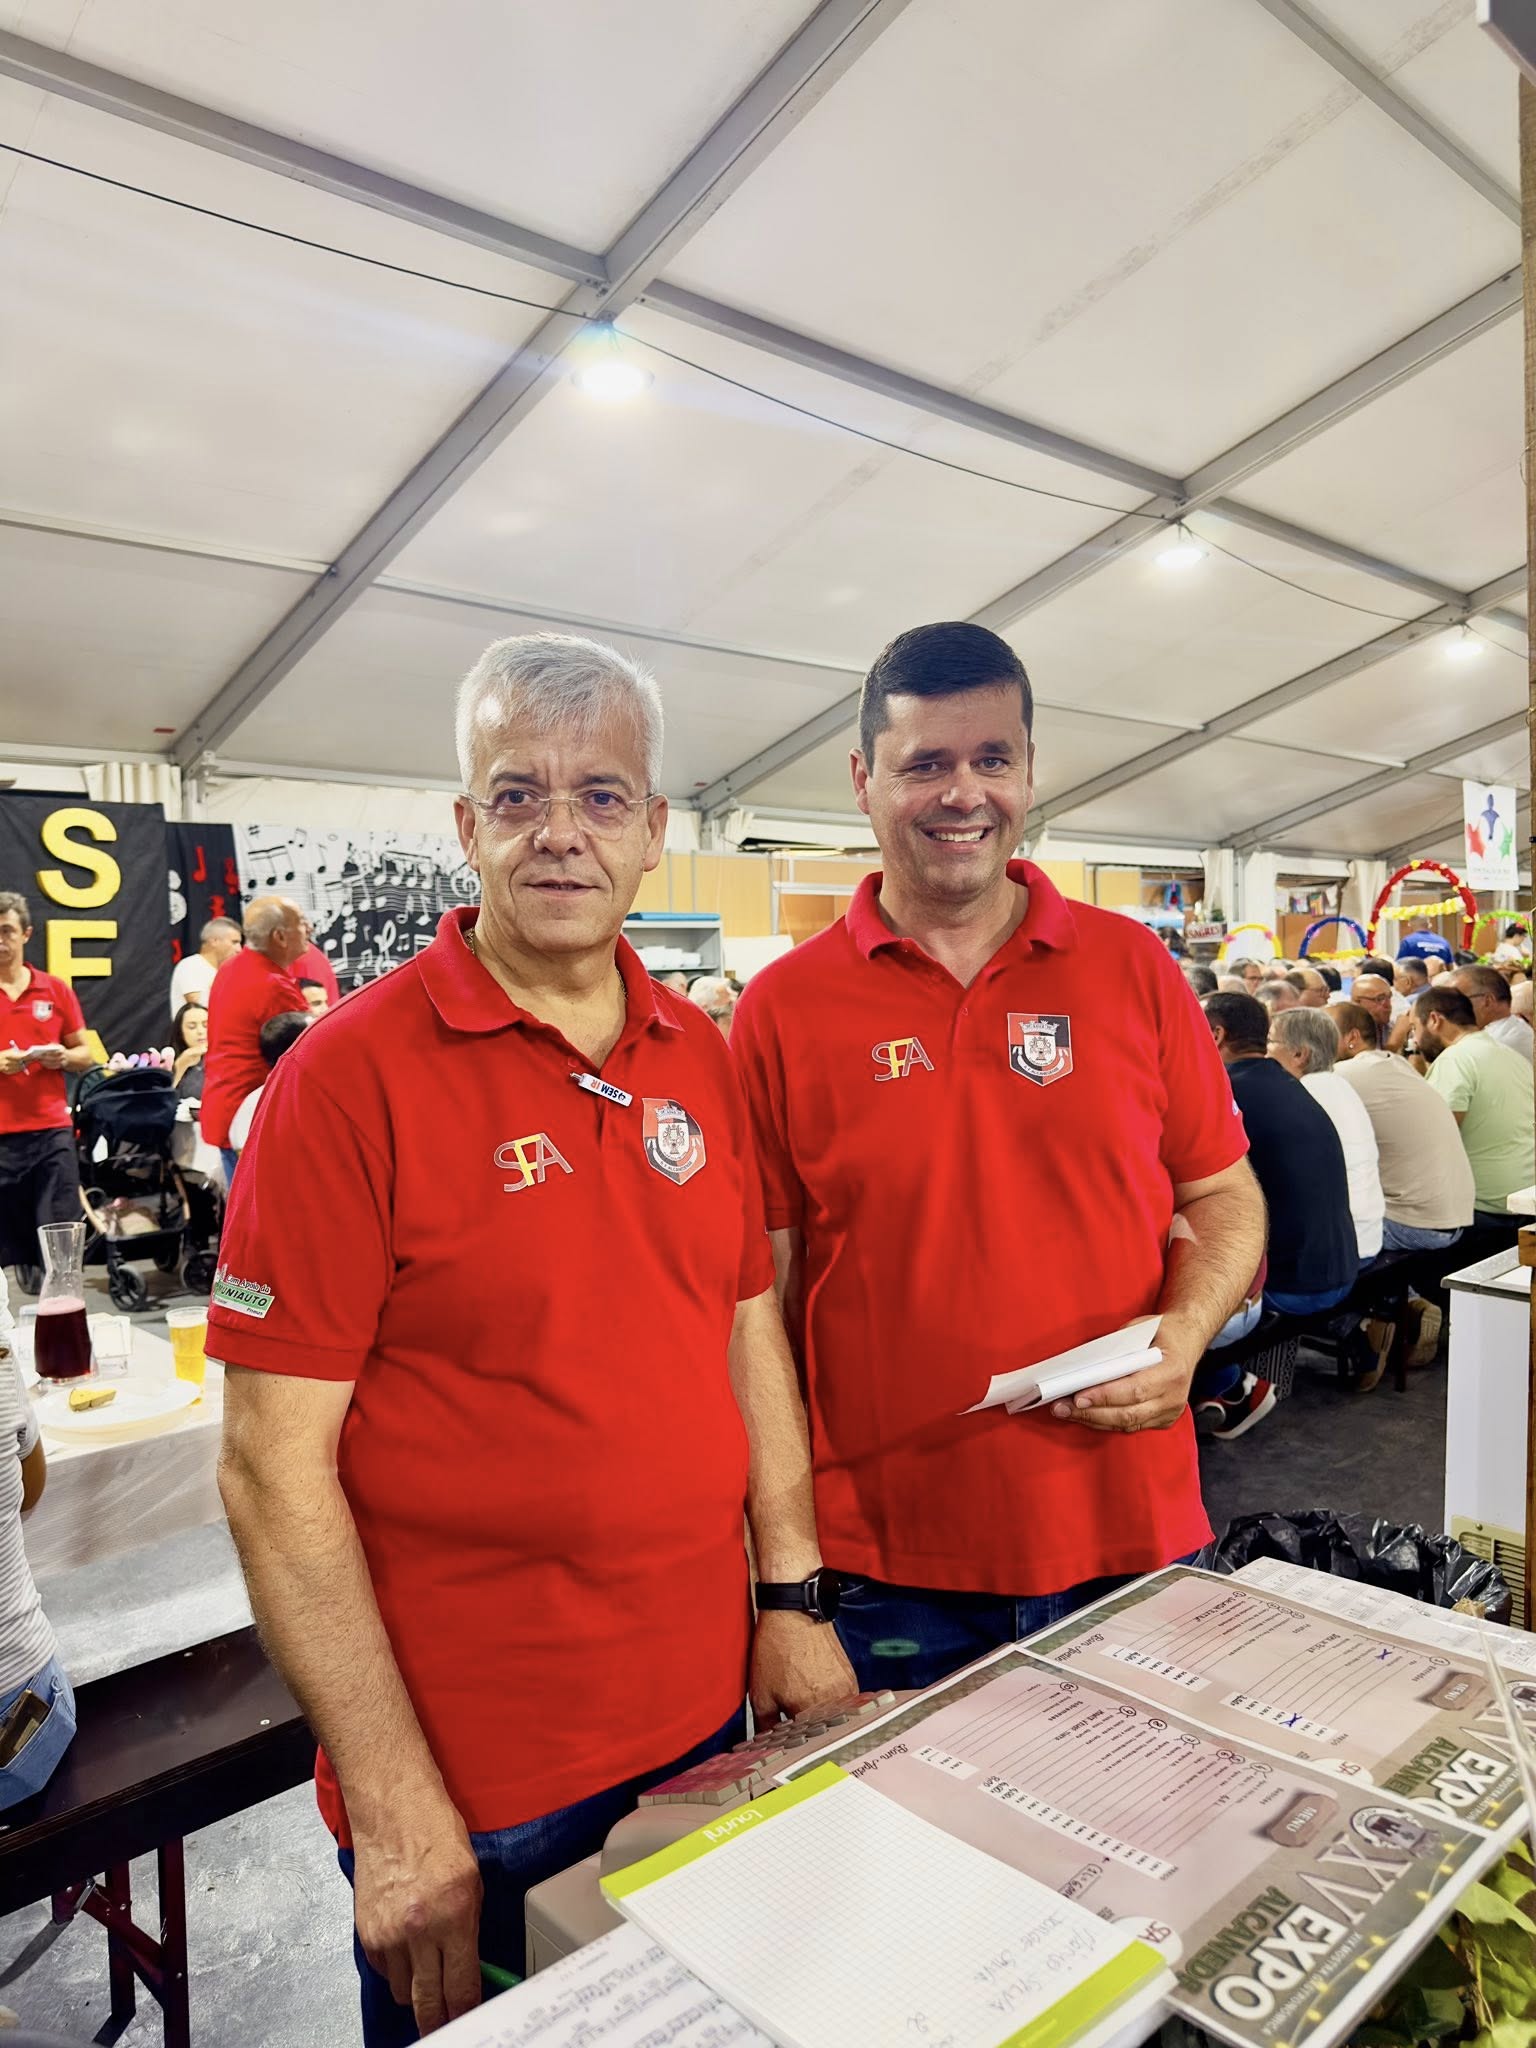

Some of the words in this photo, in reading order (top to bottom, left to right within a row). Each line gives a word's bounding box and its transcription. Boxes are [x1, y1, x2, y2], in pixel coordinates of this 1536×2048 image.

[871, 1035, 935, 1083] SFA
[493, 1132, 574, 1194] SFA
[1046, 1700, 1084, 1722] Sobremesas
[845, 1756, 886, 1779] Apetit
[876, 1742, 912, 1762] Bom
[1380, 1735, 1461, 1798] ALCANE
[1281, 1805, 1320, 1832] MENU
[1294, 1830, 1415, 1925] XV
[1209, 1903, 1352, 2020] EXPO
